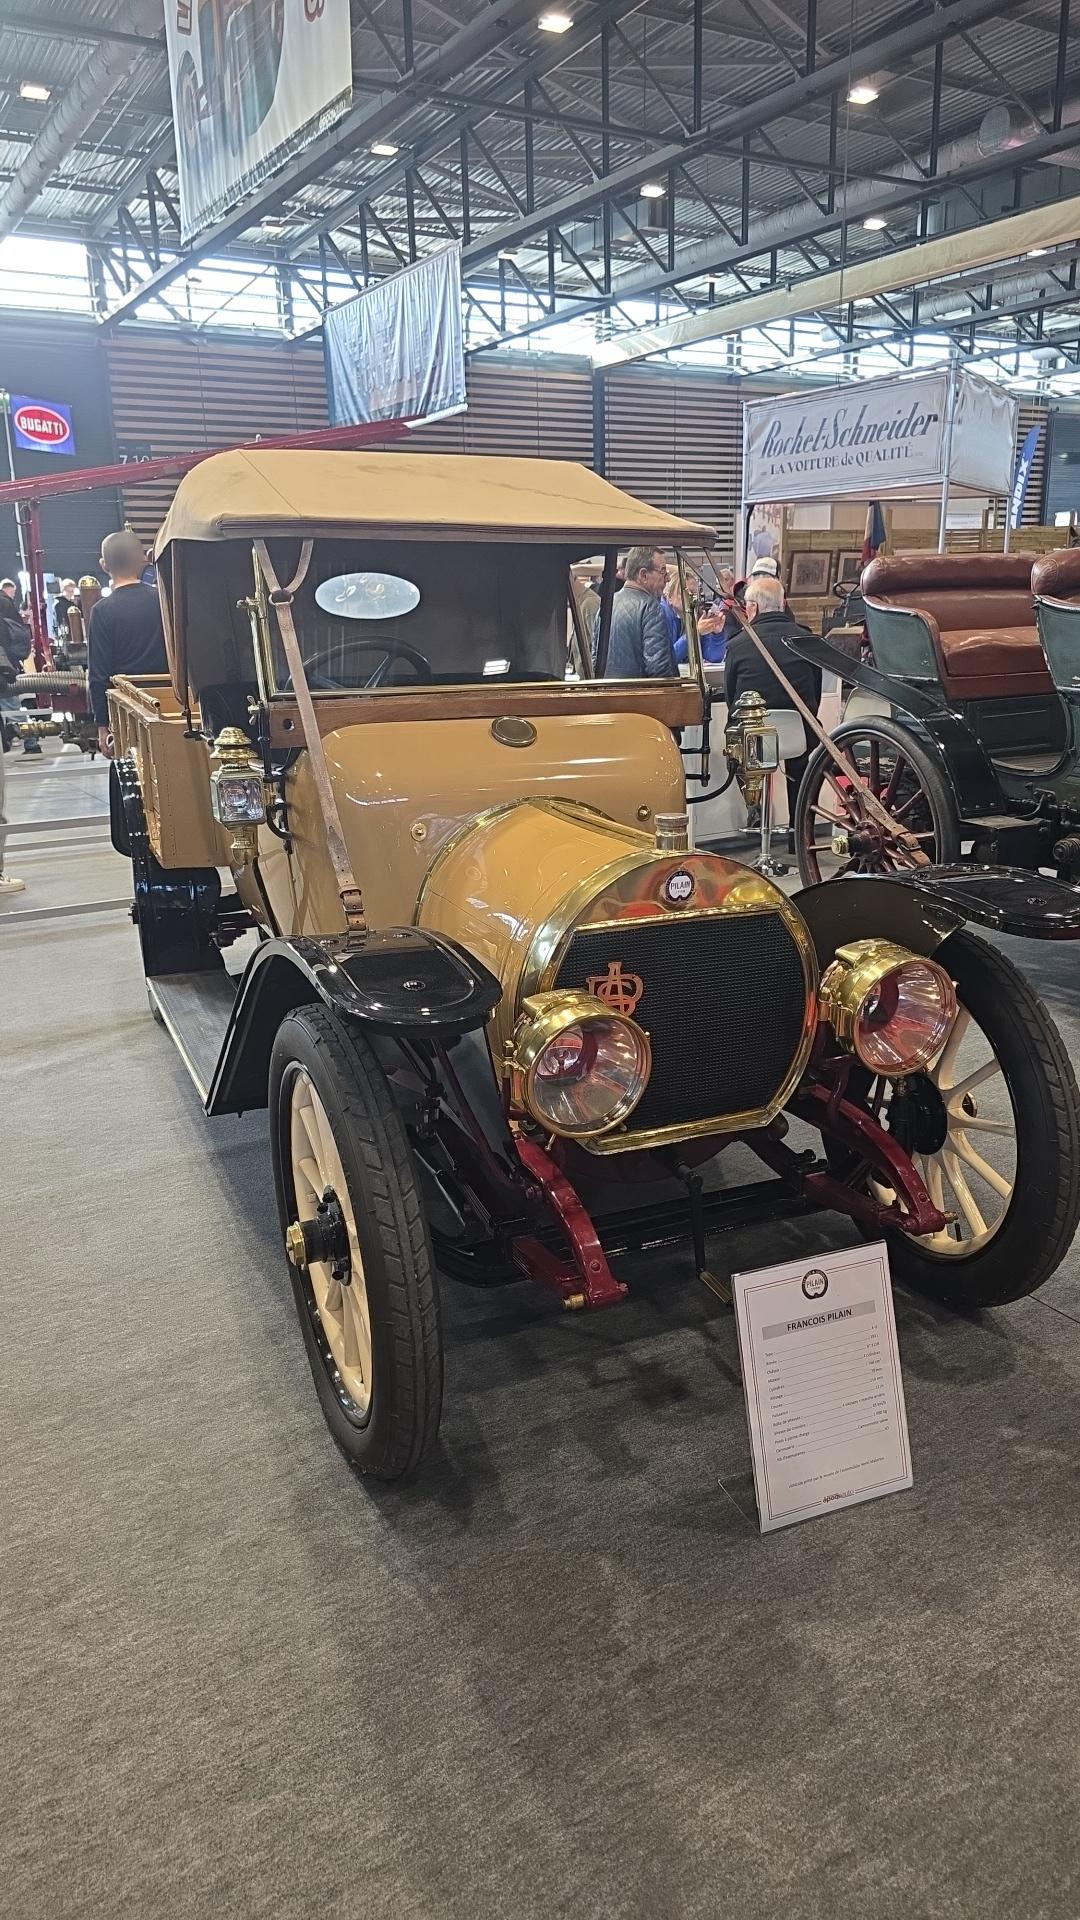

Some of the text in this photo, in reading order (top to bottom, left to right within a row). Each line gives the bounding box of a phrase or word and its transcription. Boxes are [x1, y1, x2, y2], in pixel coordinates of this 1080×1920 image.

[20, 416, 63, 436] BUGATTI
[760, 402, 939, 459] Rochet-Schneider
[770, 442, 913, 476] LA VOITURE de QUALITÉ
[670, 881, 691, 890] PILAIN
[806, 1278, 824, 1288] PILAIN
[787, 1308, 852, 1332] FRANCOIS PILAIN
